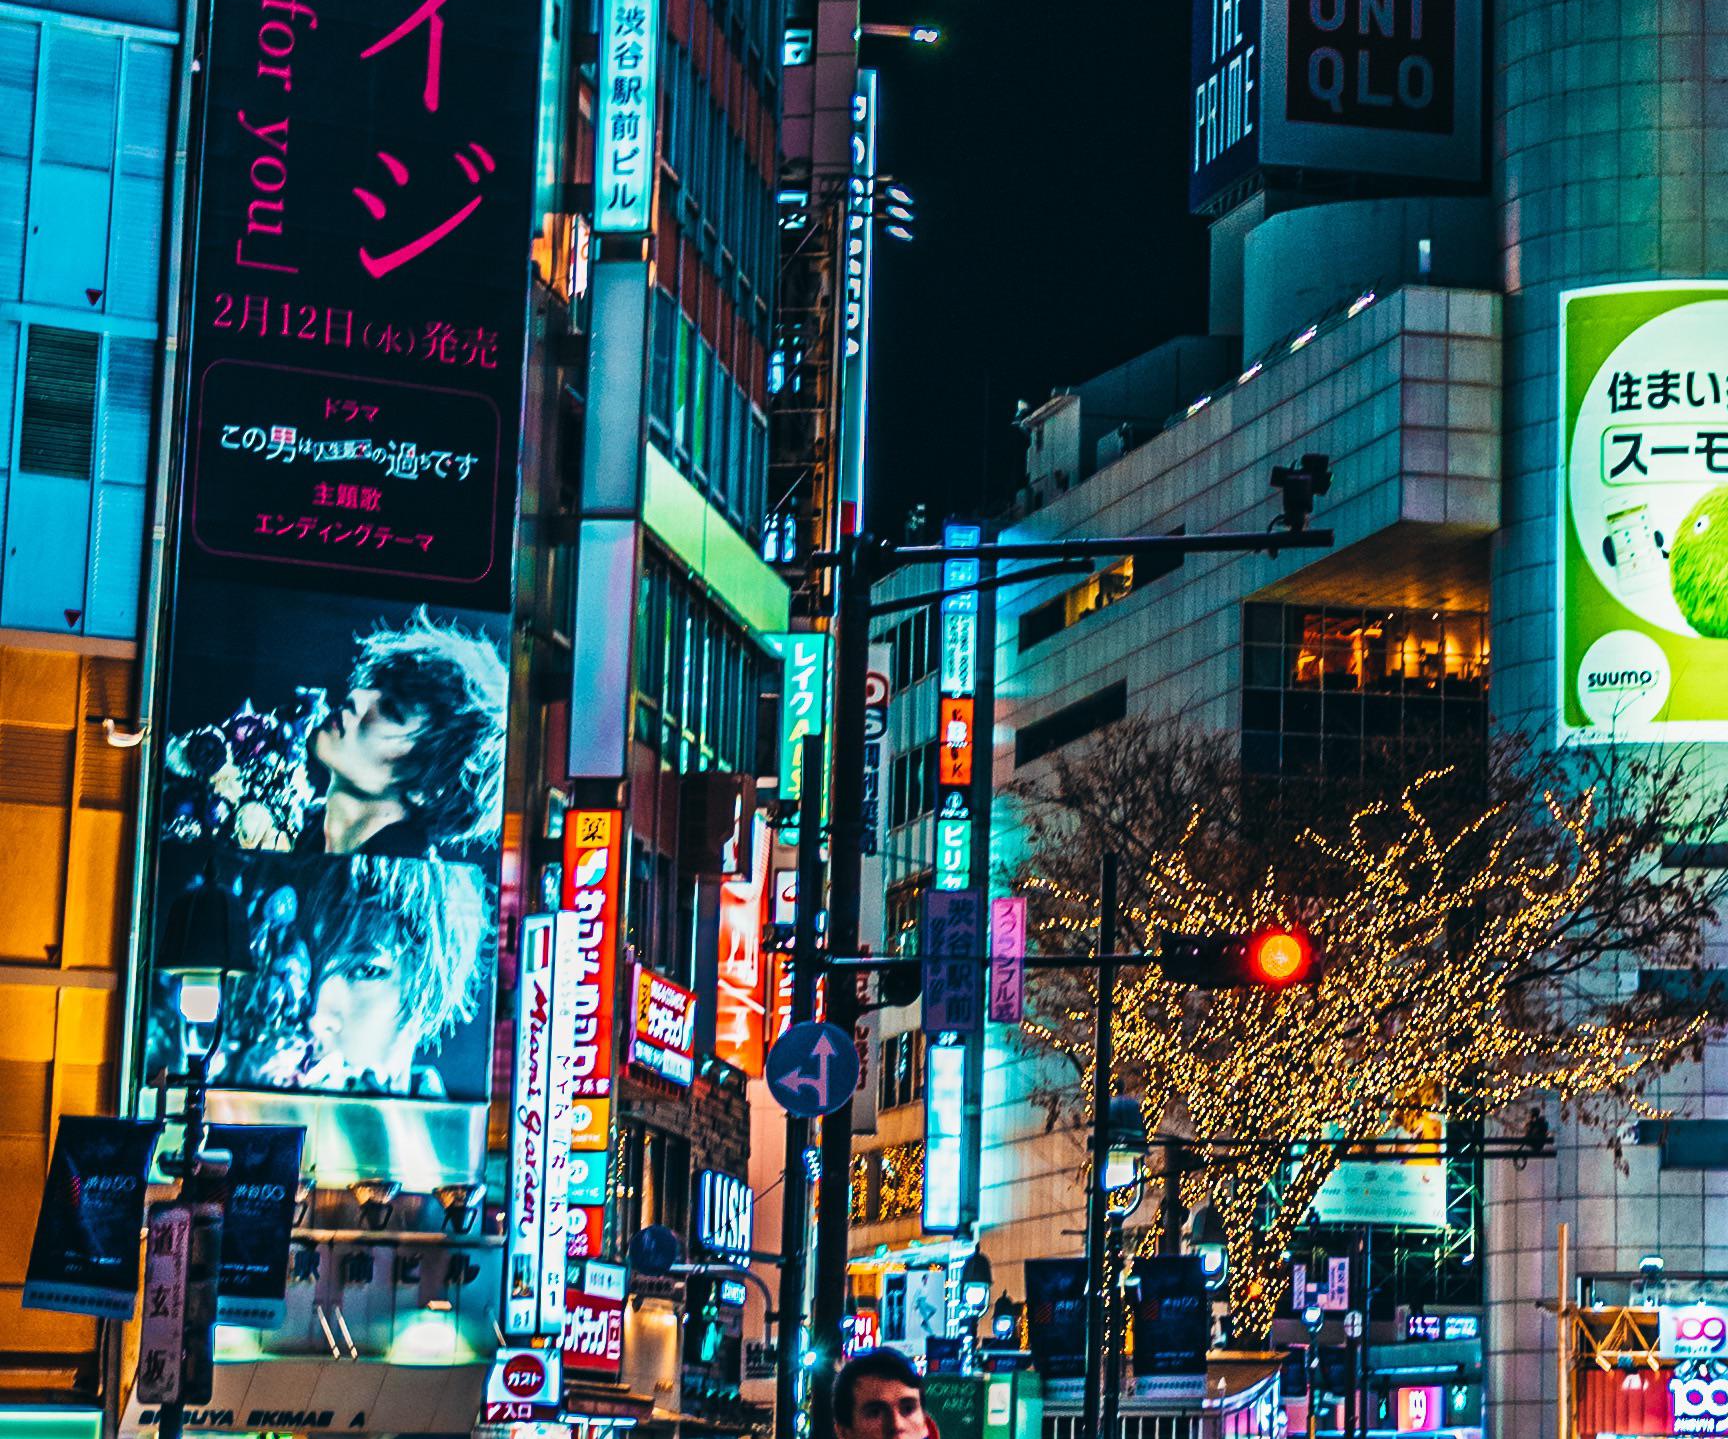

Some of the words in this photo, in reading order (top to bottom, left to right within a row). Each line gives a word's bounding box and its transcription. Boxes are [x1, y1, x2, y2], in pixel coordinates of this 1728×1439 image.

[1308, 46, 1434, 113] QLO
[607, 5, 646, 212] 渋谷駅前ビル
[1194, 45, 1254, 174] PRIME
[324, 397, 380, 423] ドラマ
[312, 481, 383, 511] 主題歌
[255, 513, 435, 552] エンディングテーマ
[789, 642, 816, 716] レイク
[1673, 1317, 1727, 1353] 109
[503, 1402, 532, 1420] 入口
